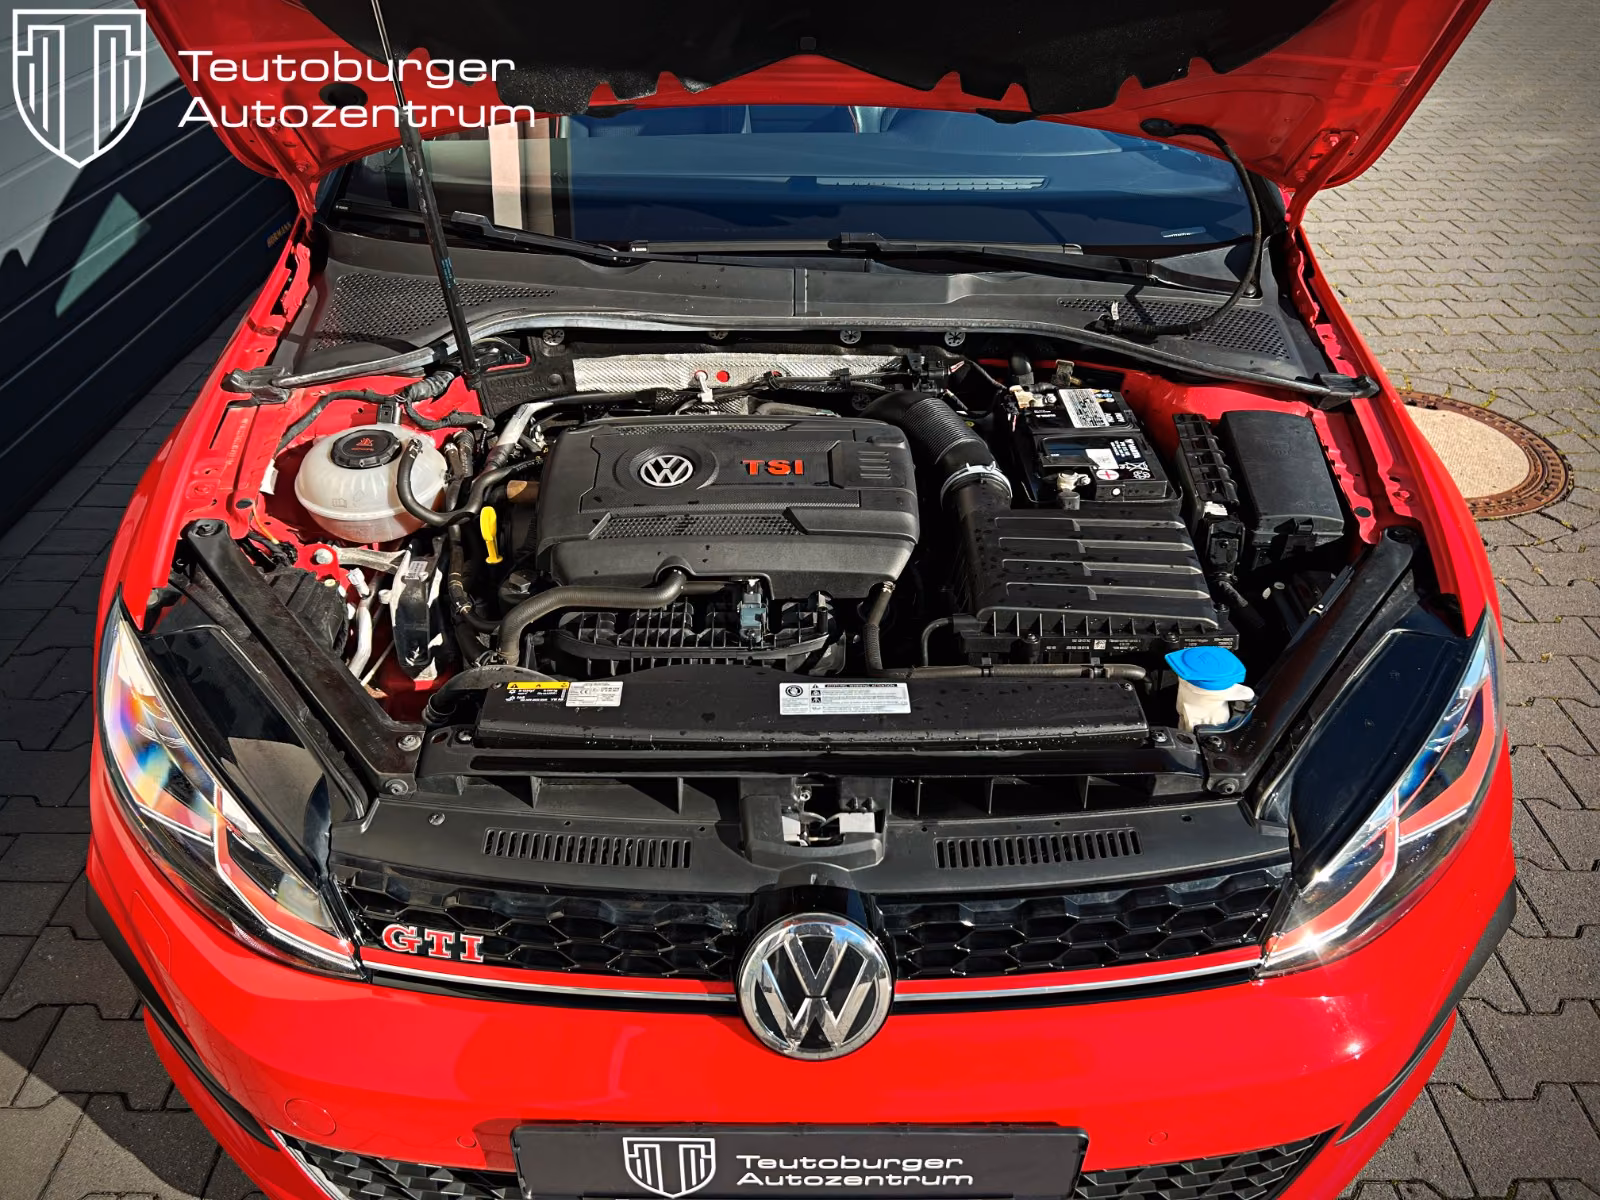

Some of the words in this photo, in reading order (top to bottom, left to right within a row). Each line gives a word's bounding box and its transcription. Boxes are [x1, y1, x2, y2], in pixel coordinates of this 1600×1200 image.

[741, 459, 804, 475] TSI
[381, 923, 484, 963] GTI
[736, 1154, 964, 1171] Teutoburger
[736, 1171, 974, 1187] Autozentrum
